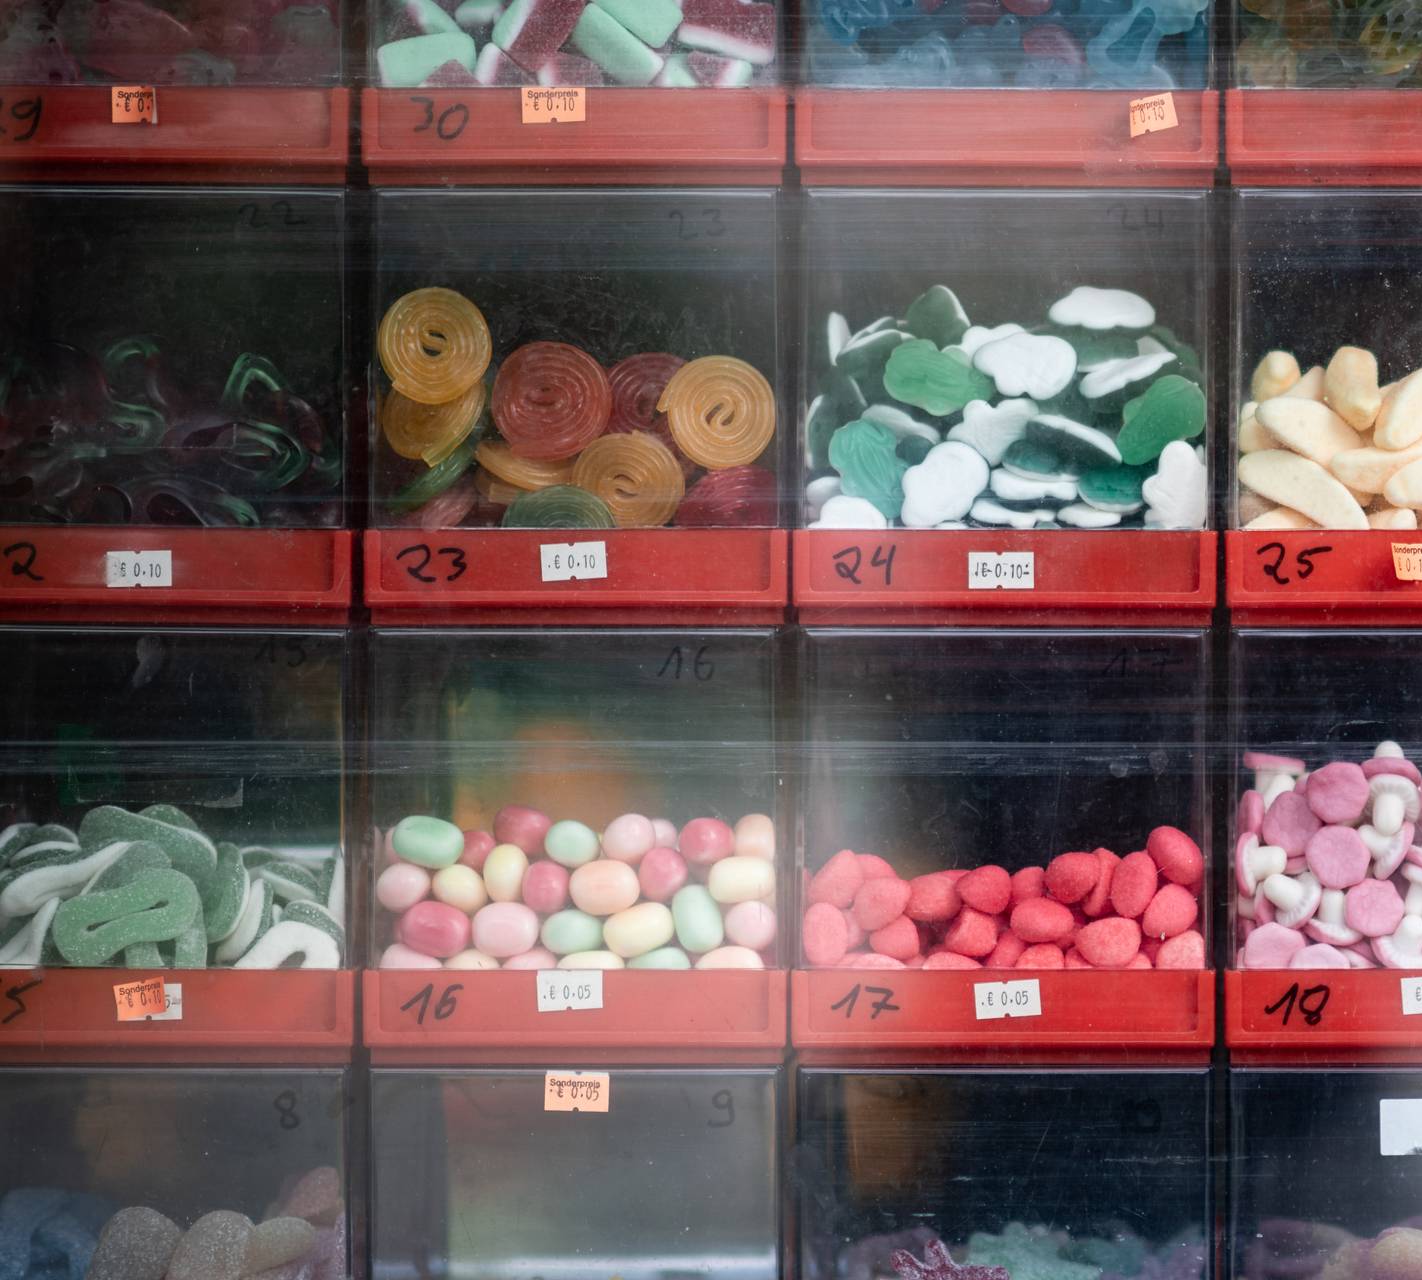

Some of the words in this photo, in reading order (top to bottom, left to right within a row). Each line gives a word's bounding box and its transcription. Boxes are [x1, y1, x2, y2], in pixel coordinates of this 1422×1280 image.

[527, 90, 579, 100] Sonderpreis
[0, 96, 42, 142] 9
[409, 95, 469, 141] 30
[237, 200, 308, 229] 22
[668, 208, 727, 241] 23
[1106, 202, 1166, 235] 24
[396, 543, 468, 584] 23
[832, 544, 897, 586] 24
[1256, 542, 1334, 585] 25
[254, 635, 308, 669] 15
[656, 645, 715, 682] 16
[1101, 646, 1185, 678] 17
[399, 983, 464, 1025] 16
[831, 983, 901, 1020] 17
[1264, 982, 1331, 1027] 18
[549, 1078, 601, 1089] Sonderpreis
[273, 1089, 301, 1131] 8
[707, 1088, 736, 1129] 9
